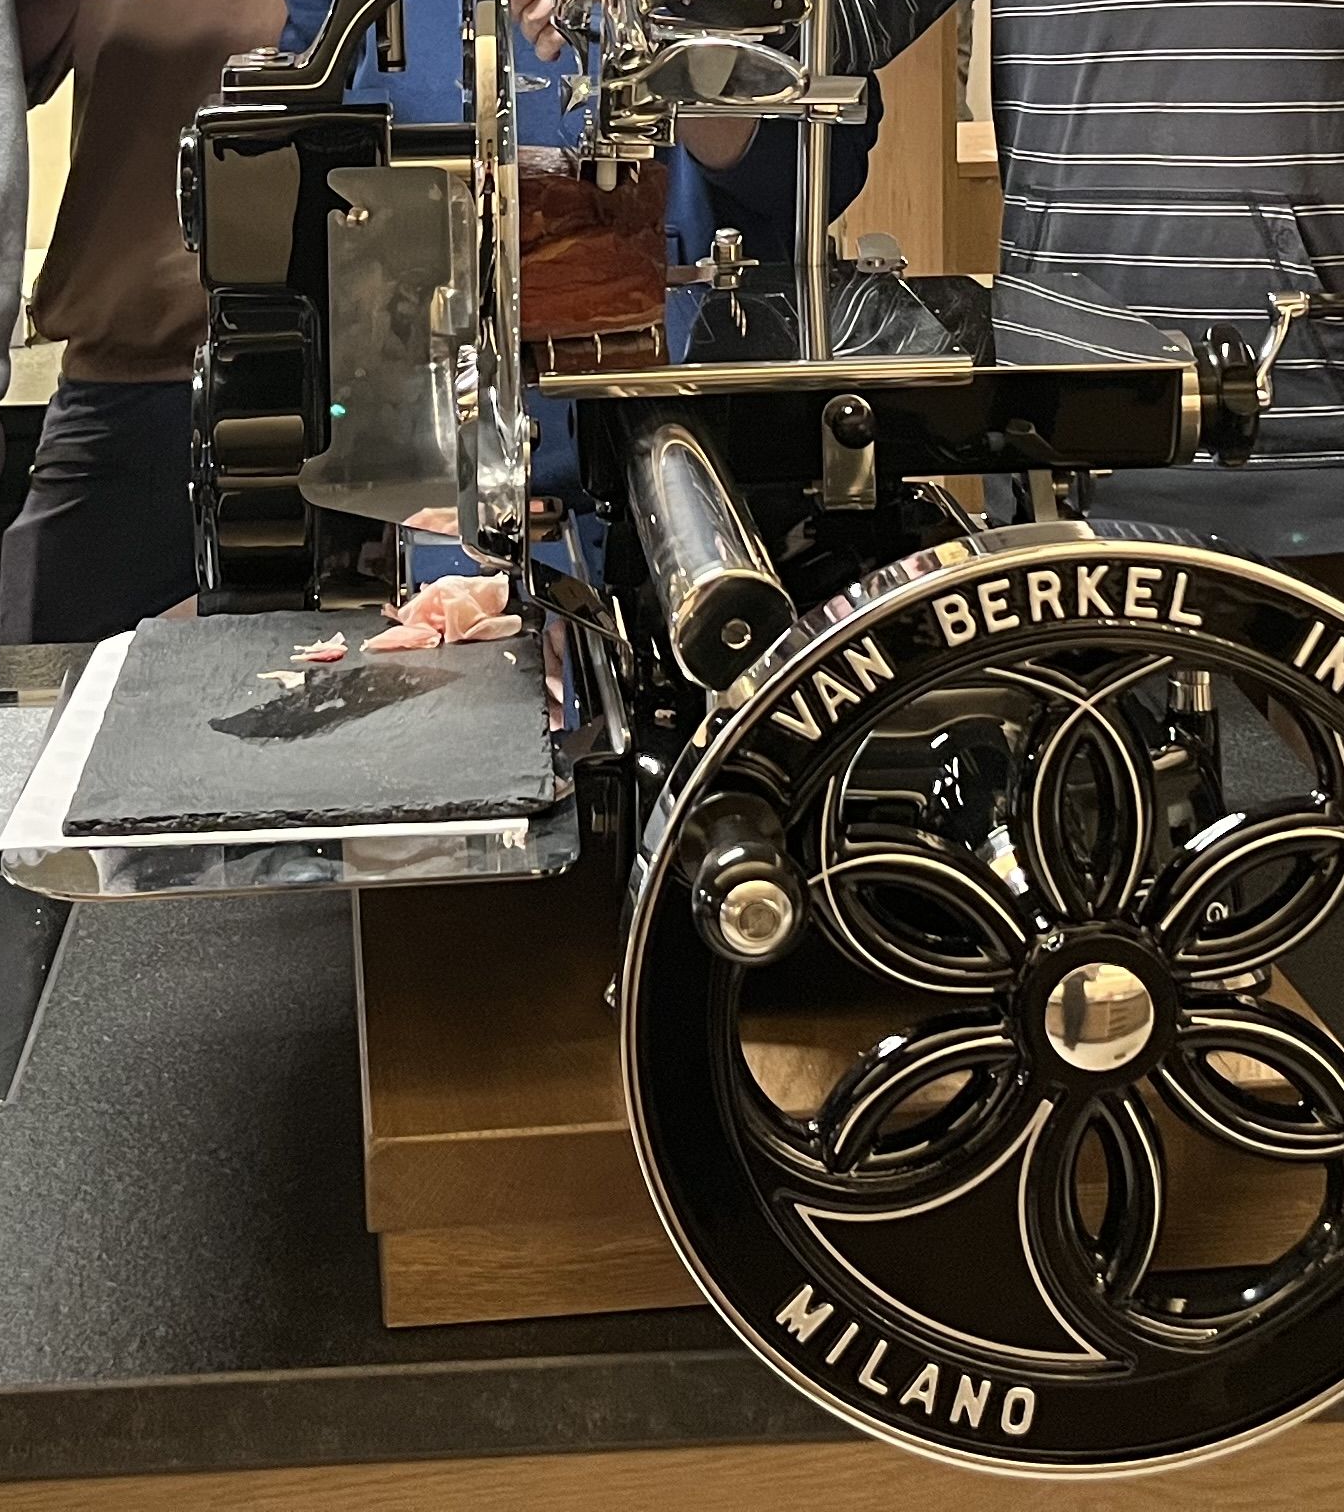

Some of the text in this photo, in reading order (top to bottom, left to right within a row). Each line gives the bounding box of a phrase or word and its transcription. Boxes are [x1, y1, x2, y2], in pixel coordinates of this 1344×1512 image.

[771, 636, 895, 741] VAN
[931, 565, 1203, 648] BERKEL
[775, 1284, 1037, 1436] MILANO
